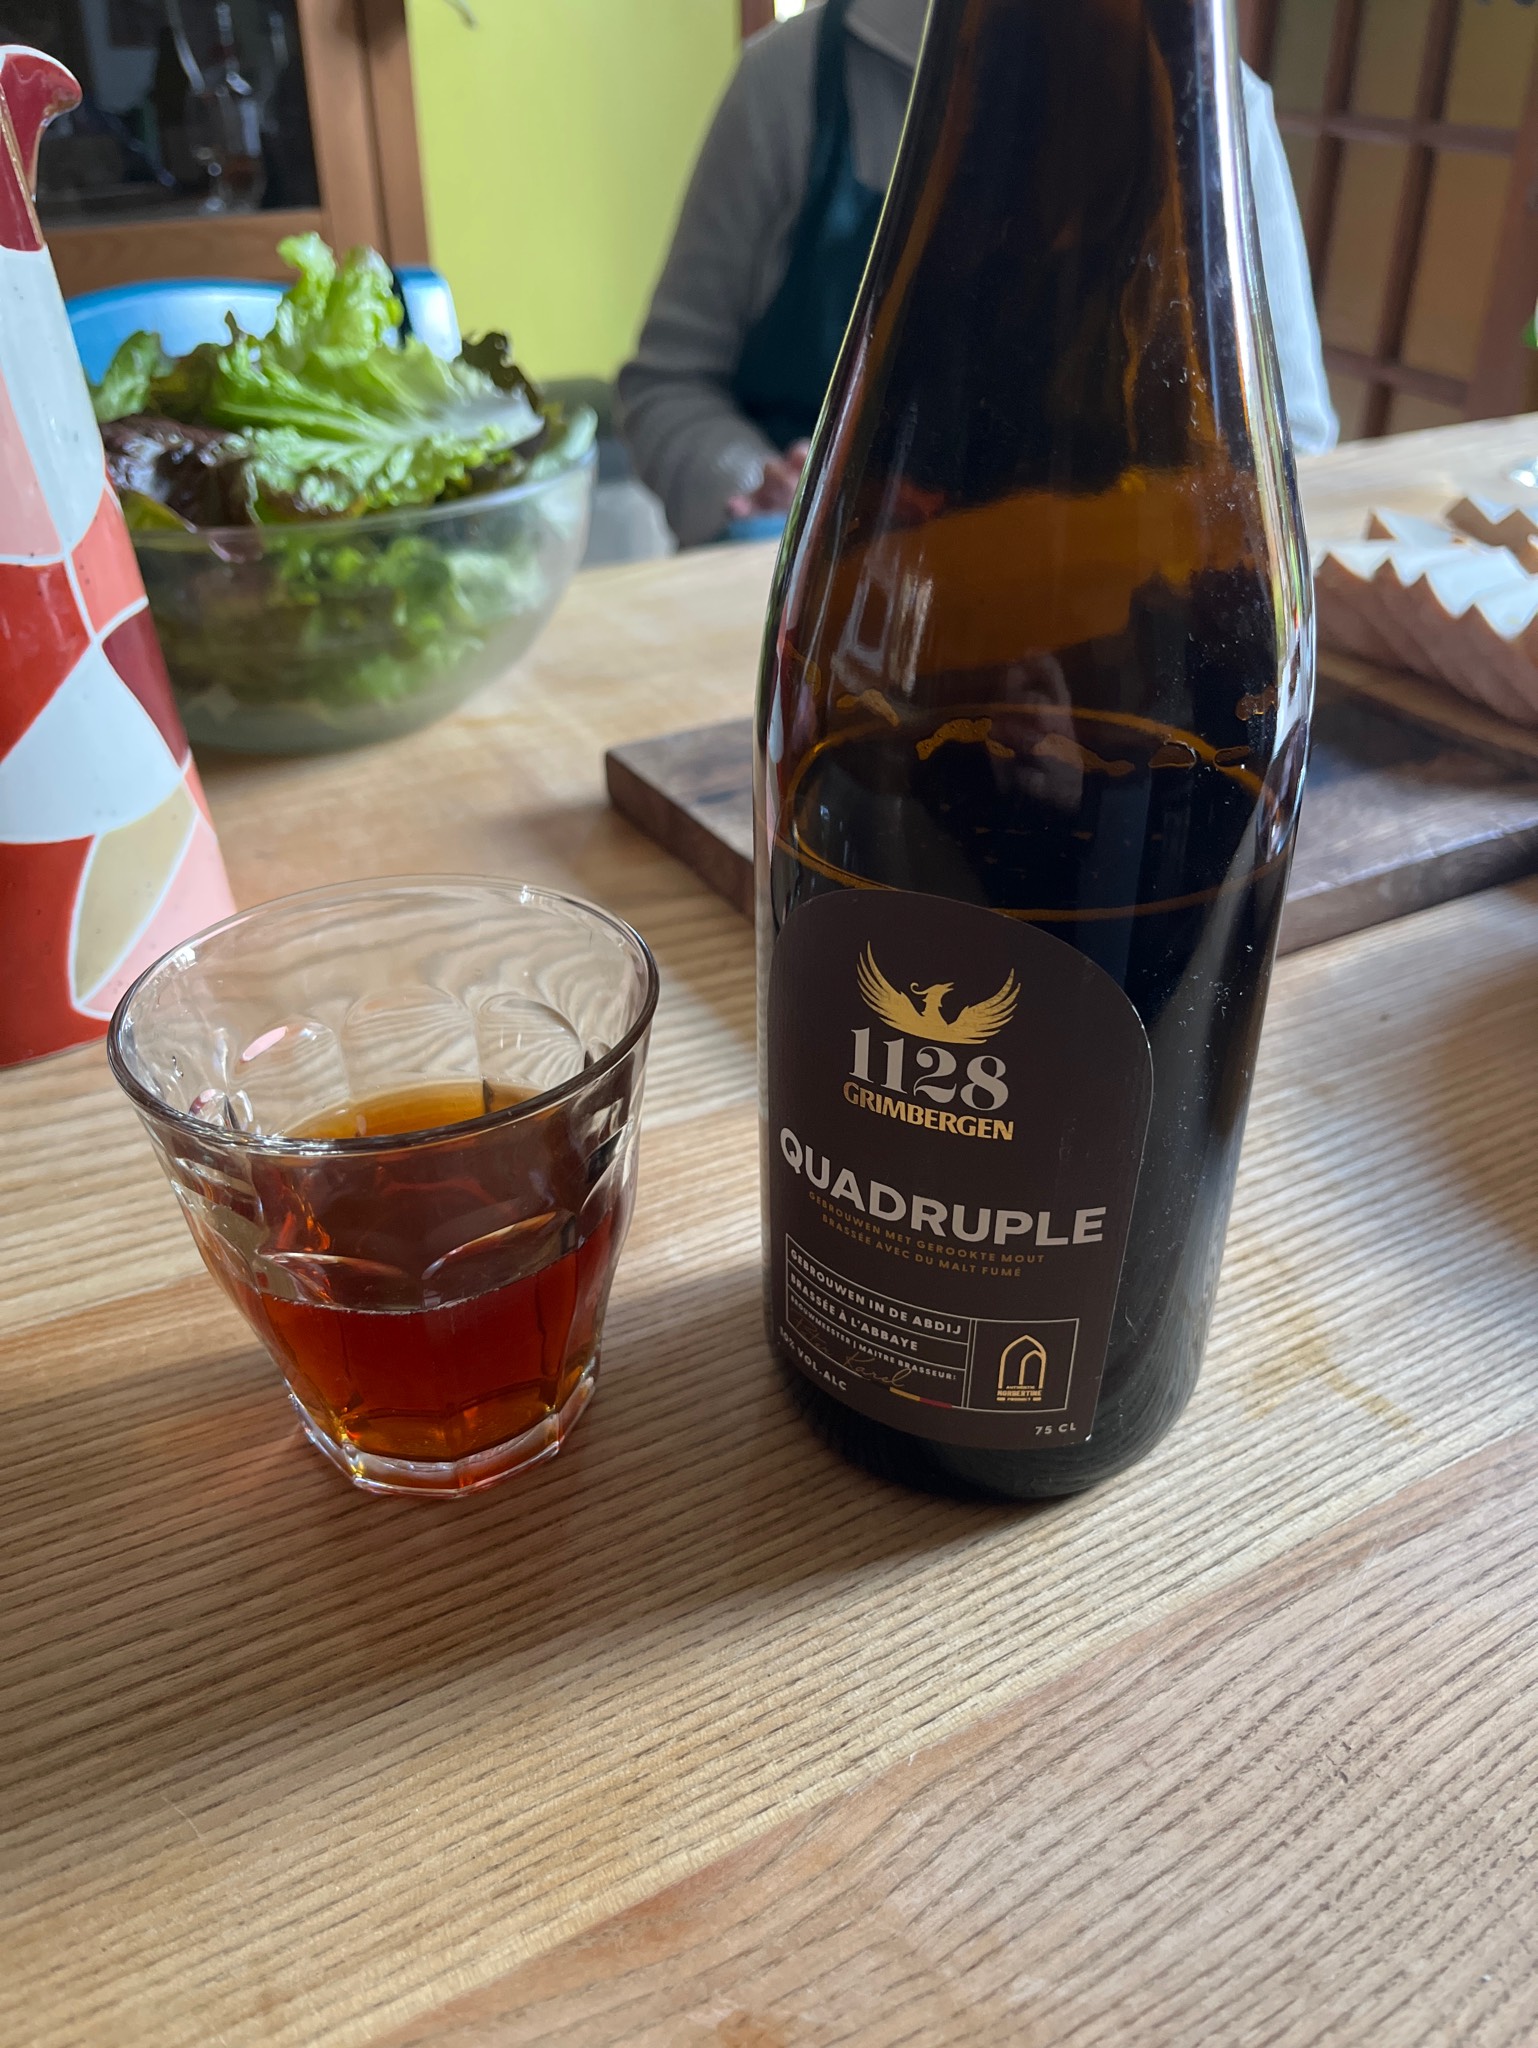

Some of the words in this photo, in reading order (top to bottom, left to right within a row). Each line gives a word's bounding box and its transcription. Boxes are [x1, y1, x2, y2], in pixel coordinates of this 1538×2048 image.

[849, 1027, 1009, 1111] 1128
[843, 1082, 1014, 1141] GRIMBERGEN
[780, 1128, 1107, 1246] QUADRUPLE
[809, 1191, 880, 1234] GEBROUWEN
[885, 1229, 911, 1245] MET
[917, 1240, 995, 1262] GEROOKTE
[1001, 1254, 1044, 1263] MOUT
[822, 1213, 871, 1245] BRASSÉE
[876, 1241, 910, 1259] AVEC
[915, 1254, 934, 1265] DU
[939, 1259, 976, 1273] MALT
[982, 1266, 1021, 1276] FUMÉ
[791, 1249, 865, 1305] GEBROUWEN
[869, 1300, 884, 1314] IN
[889, 1307, 908, 1322] DE
[912, 1316, 961, 1335] ABDIJ
[791, 1273, 835, 1315] BRASSÉE
[839, 1310, 847, 1322] À
[851, 1317, 918, 1351] L'ABBAYE
[1035, 1426, 1052, 1435] 75
[1058, 1422, 1076, 1433] CL
